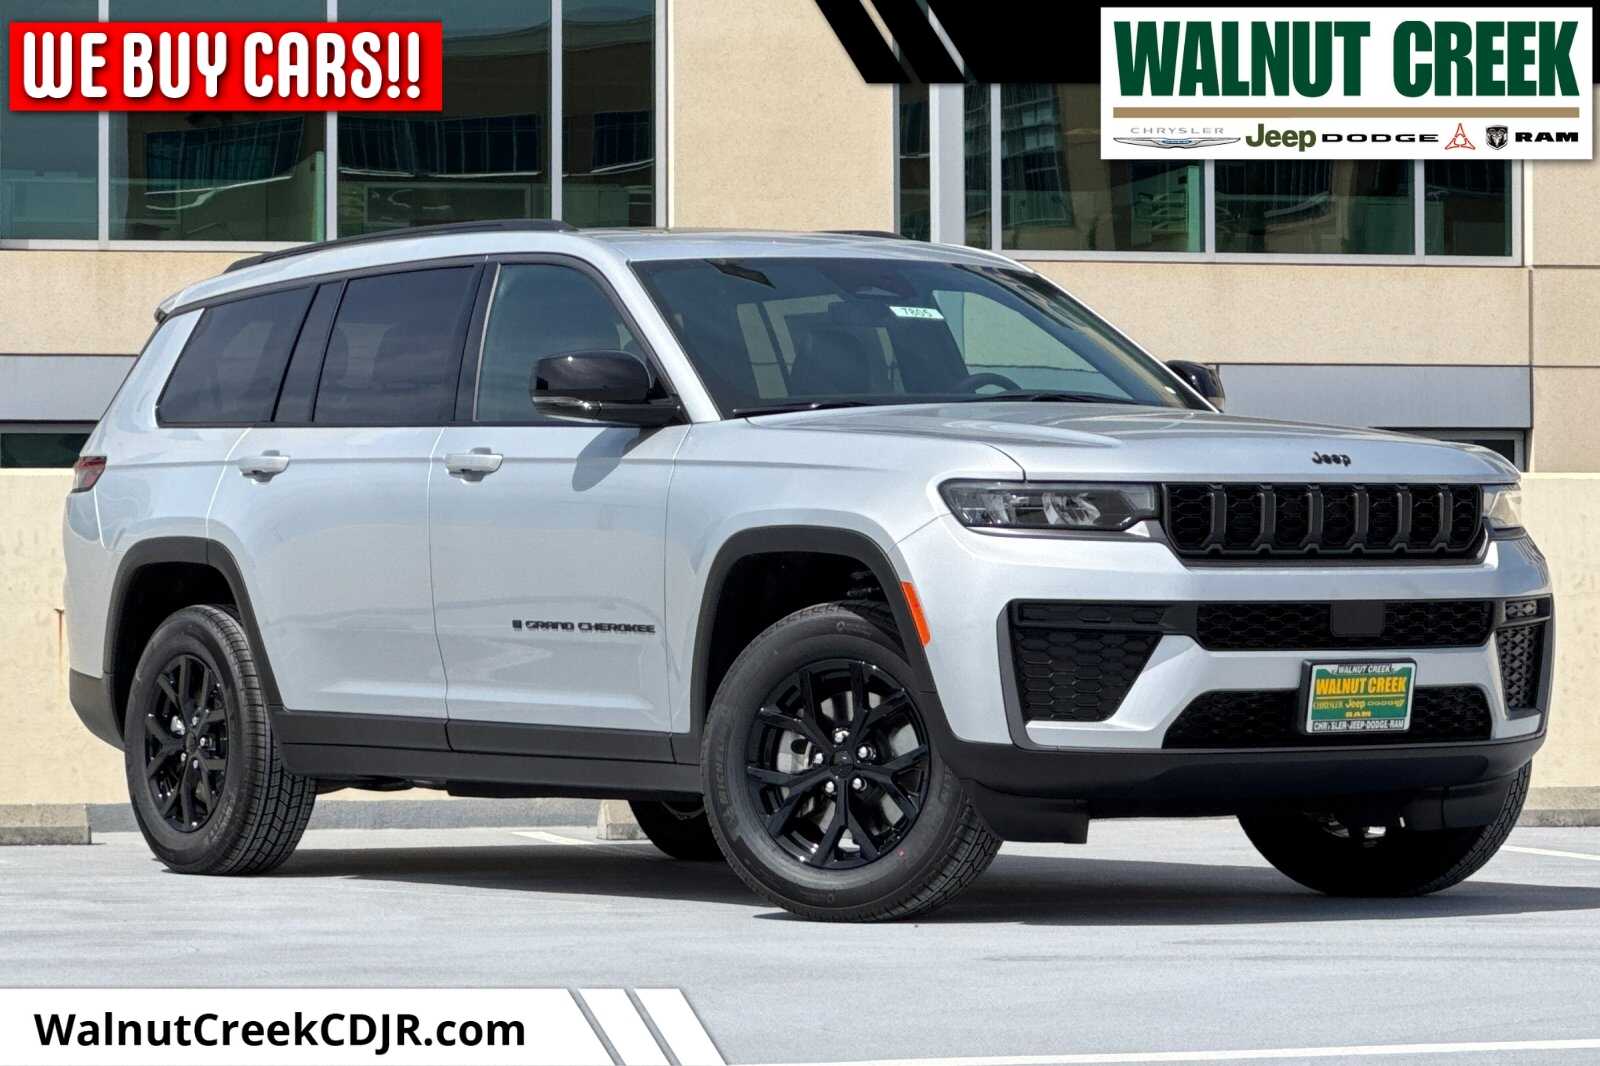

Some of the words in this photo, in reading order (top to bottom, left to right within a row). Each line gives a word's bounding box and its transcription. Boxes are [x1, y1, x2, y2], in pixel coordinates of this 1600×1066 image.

[1312, 451, 1352, 467] Jeep
[525, 620, 574, 631] GRAND
[578, 622, 656, 634] CHEROKEE
[1338, 665, 1367, 674] WALNUT
[1368, 665, 1390, 673] CREEK
[1316, 678, 1367, 695] WALNUT
[1367, 677, 1407, 693] CREEK
